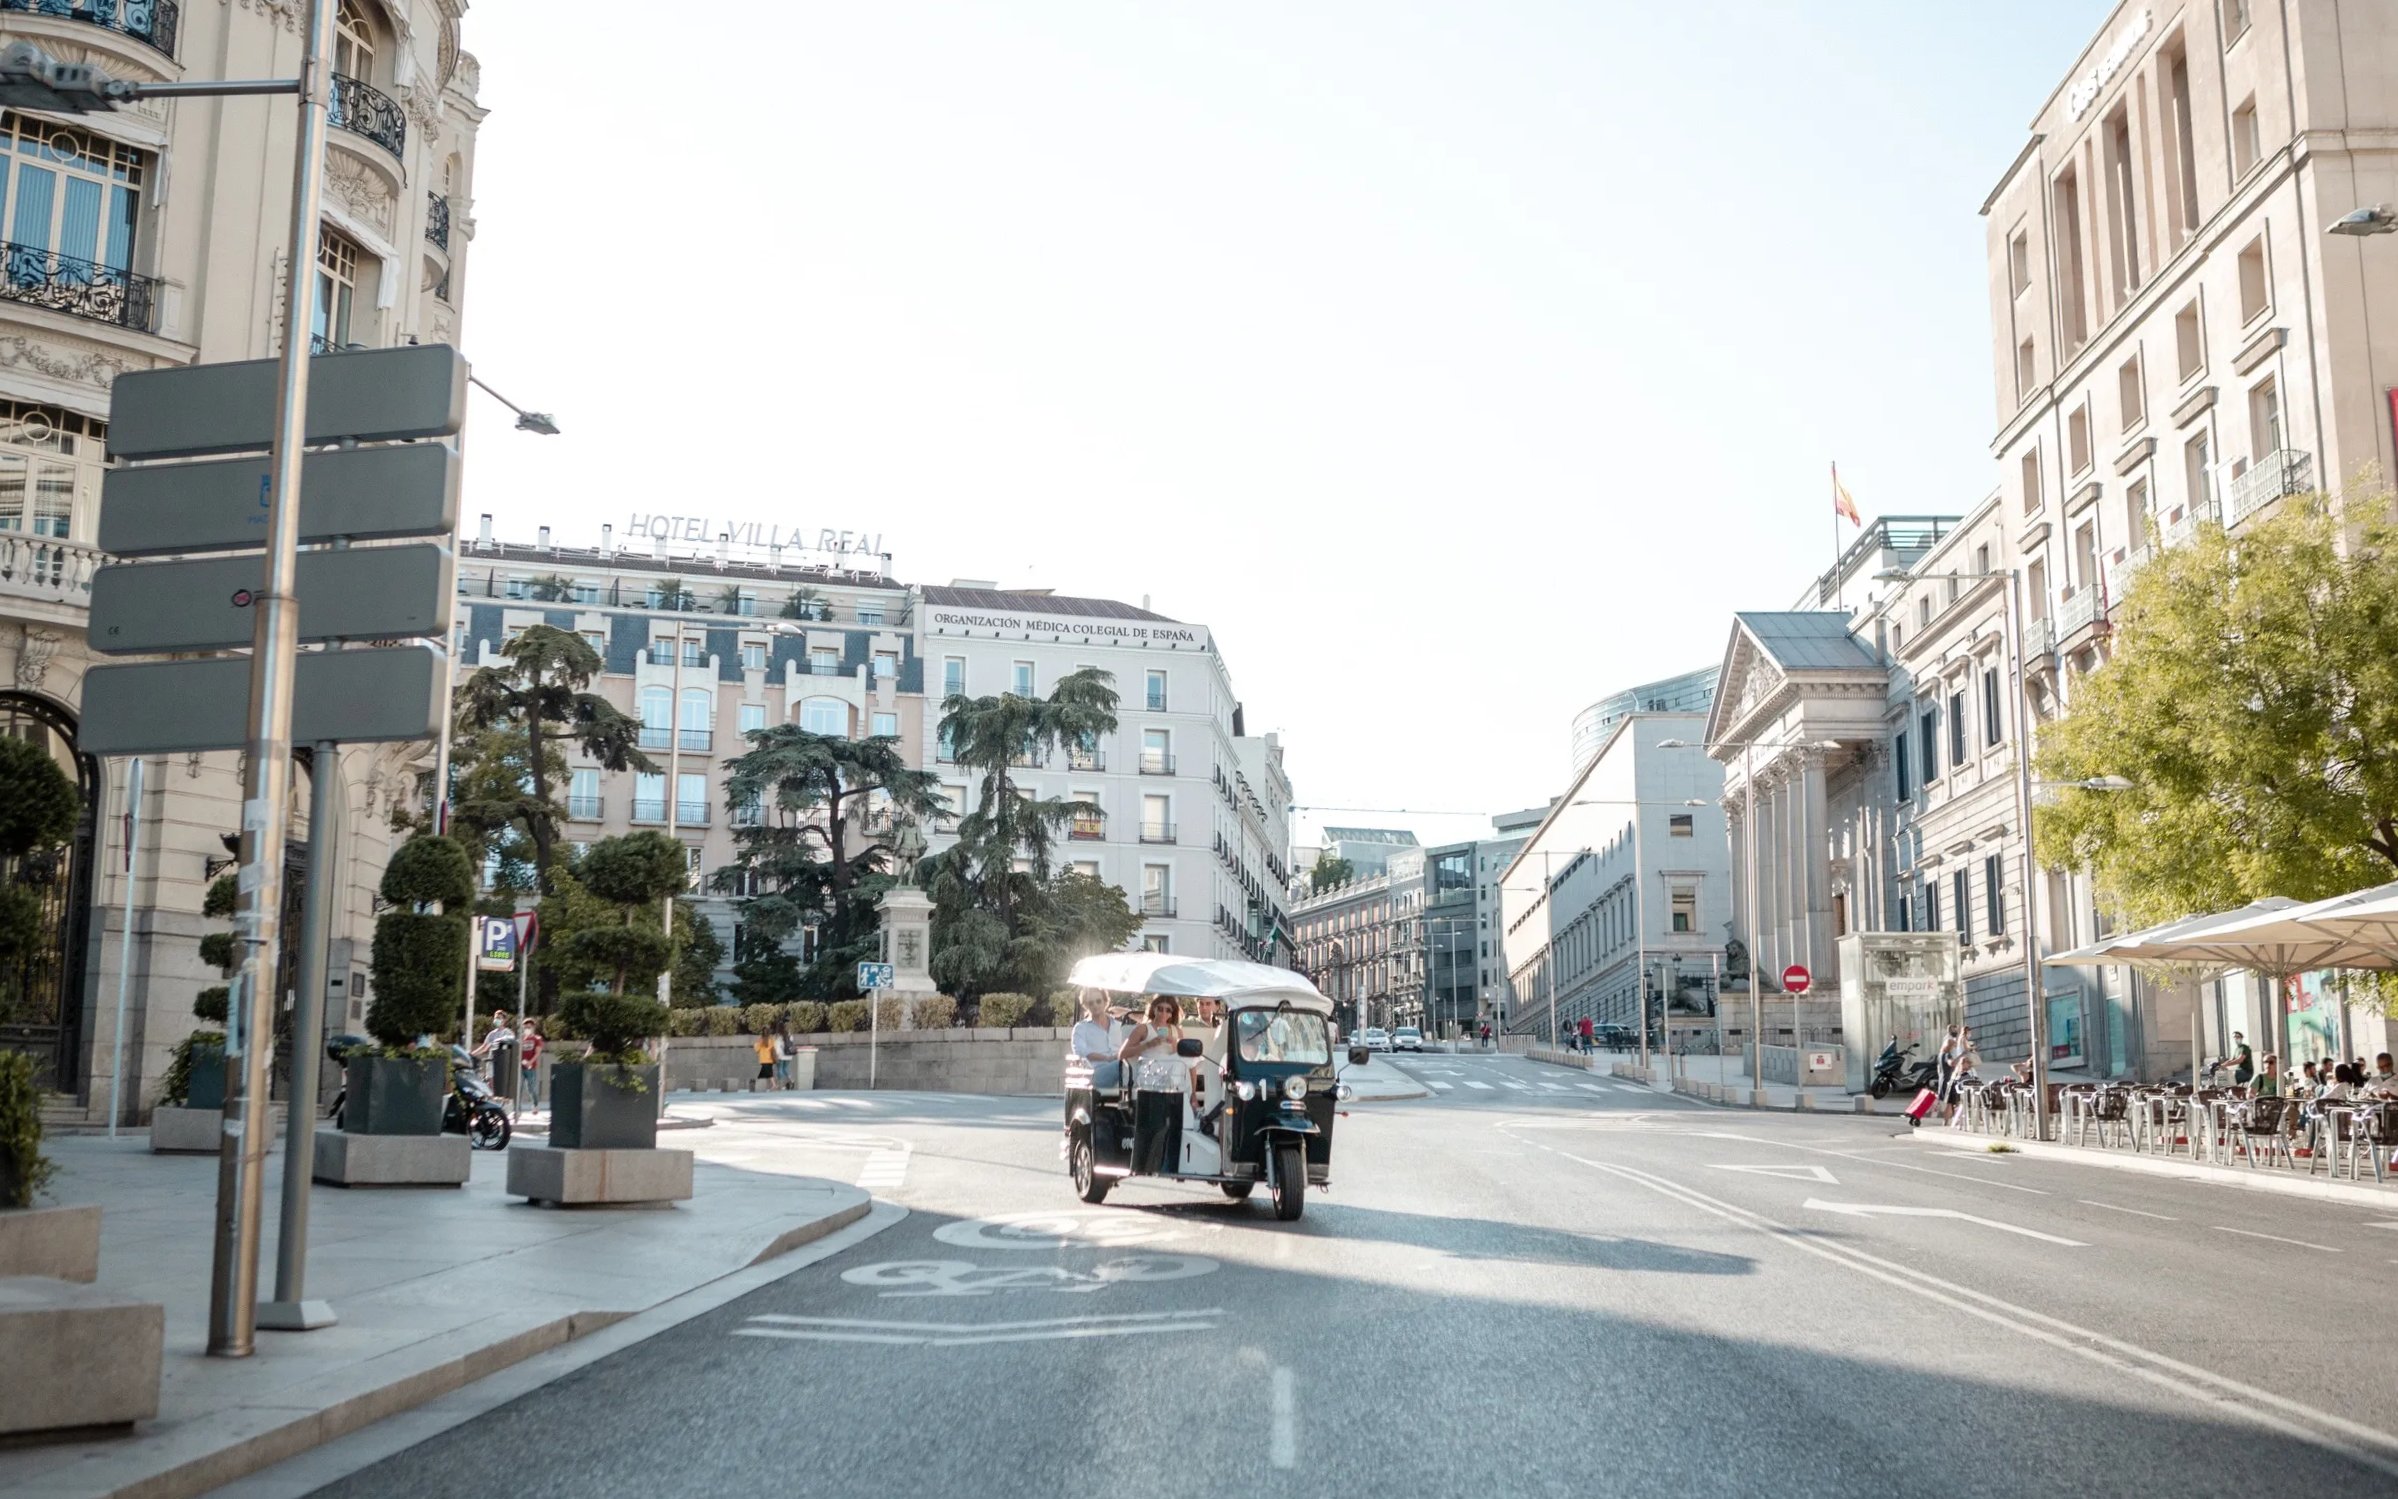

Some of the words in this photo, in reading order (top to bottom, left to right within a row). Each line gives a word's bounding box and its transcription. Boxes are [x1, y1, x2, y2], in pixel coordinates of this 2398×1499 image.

[628, 512, 713, 543] HOTEL
[727, 520, 804, 550] VILLA
[817, 528, 884, 557] REAL
[934, 613, 1021, 629] ORGANIZACIÓN
[1026, 619, 1070, 634] MÉDICA
[1073, 624, 1130, 637] COLEGIAL
[1132, 627, 1147, 639] DE
[1152, 628, 1194, 642] ESPAÑA
[485, 920, 507, 951] P
[1889, 979, 1935, 993] empark
[1259, 1079, 1267, 1102] 1
[1186, 1143, 1191, 1163] 1
